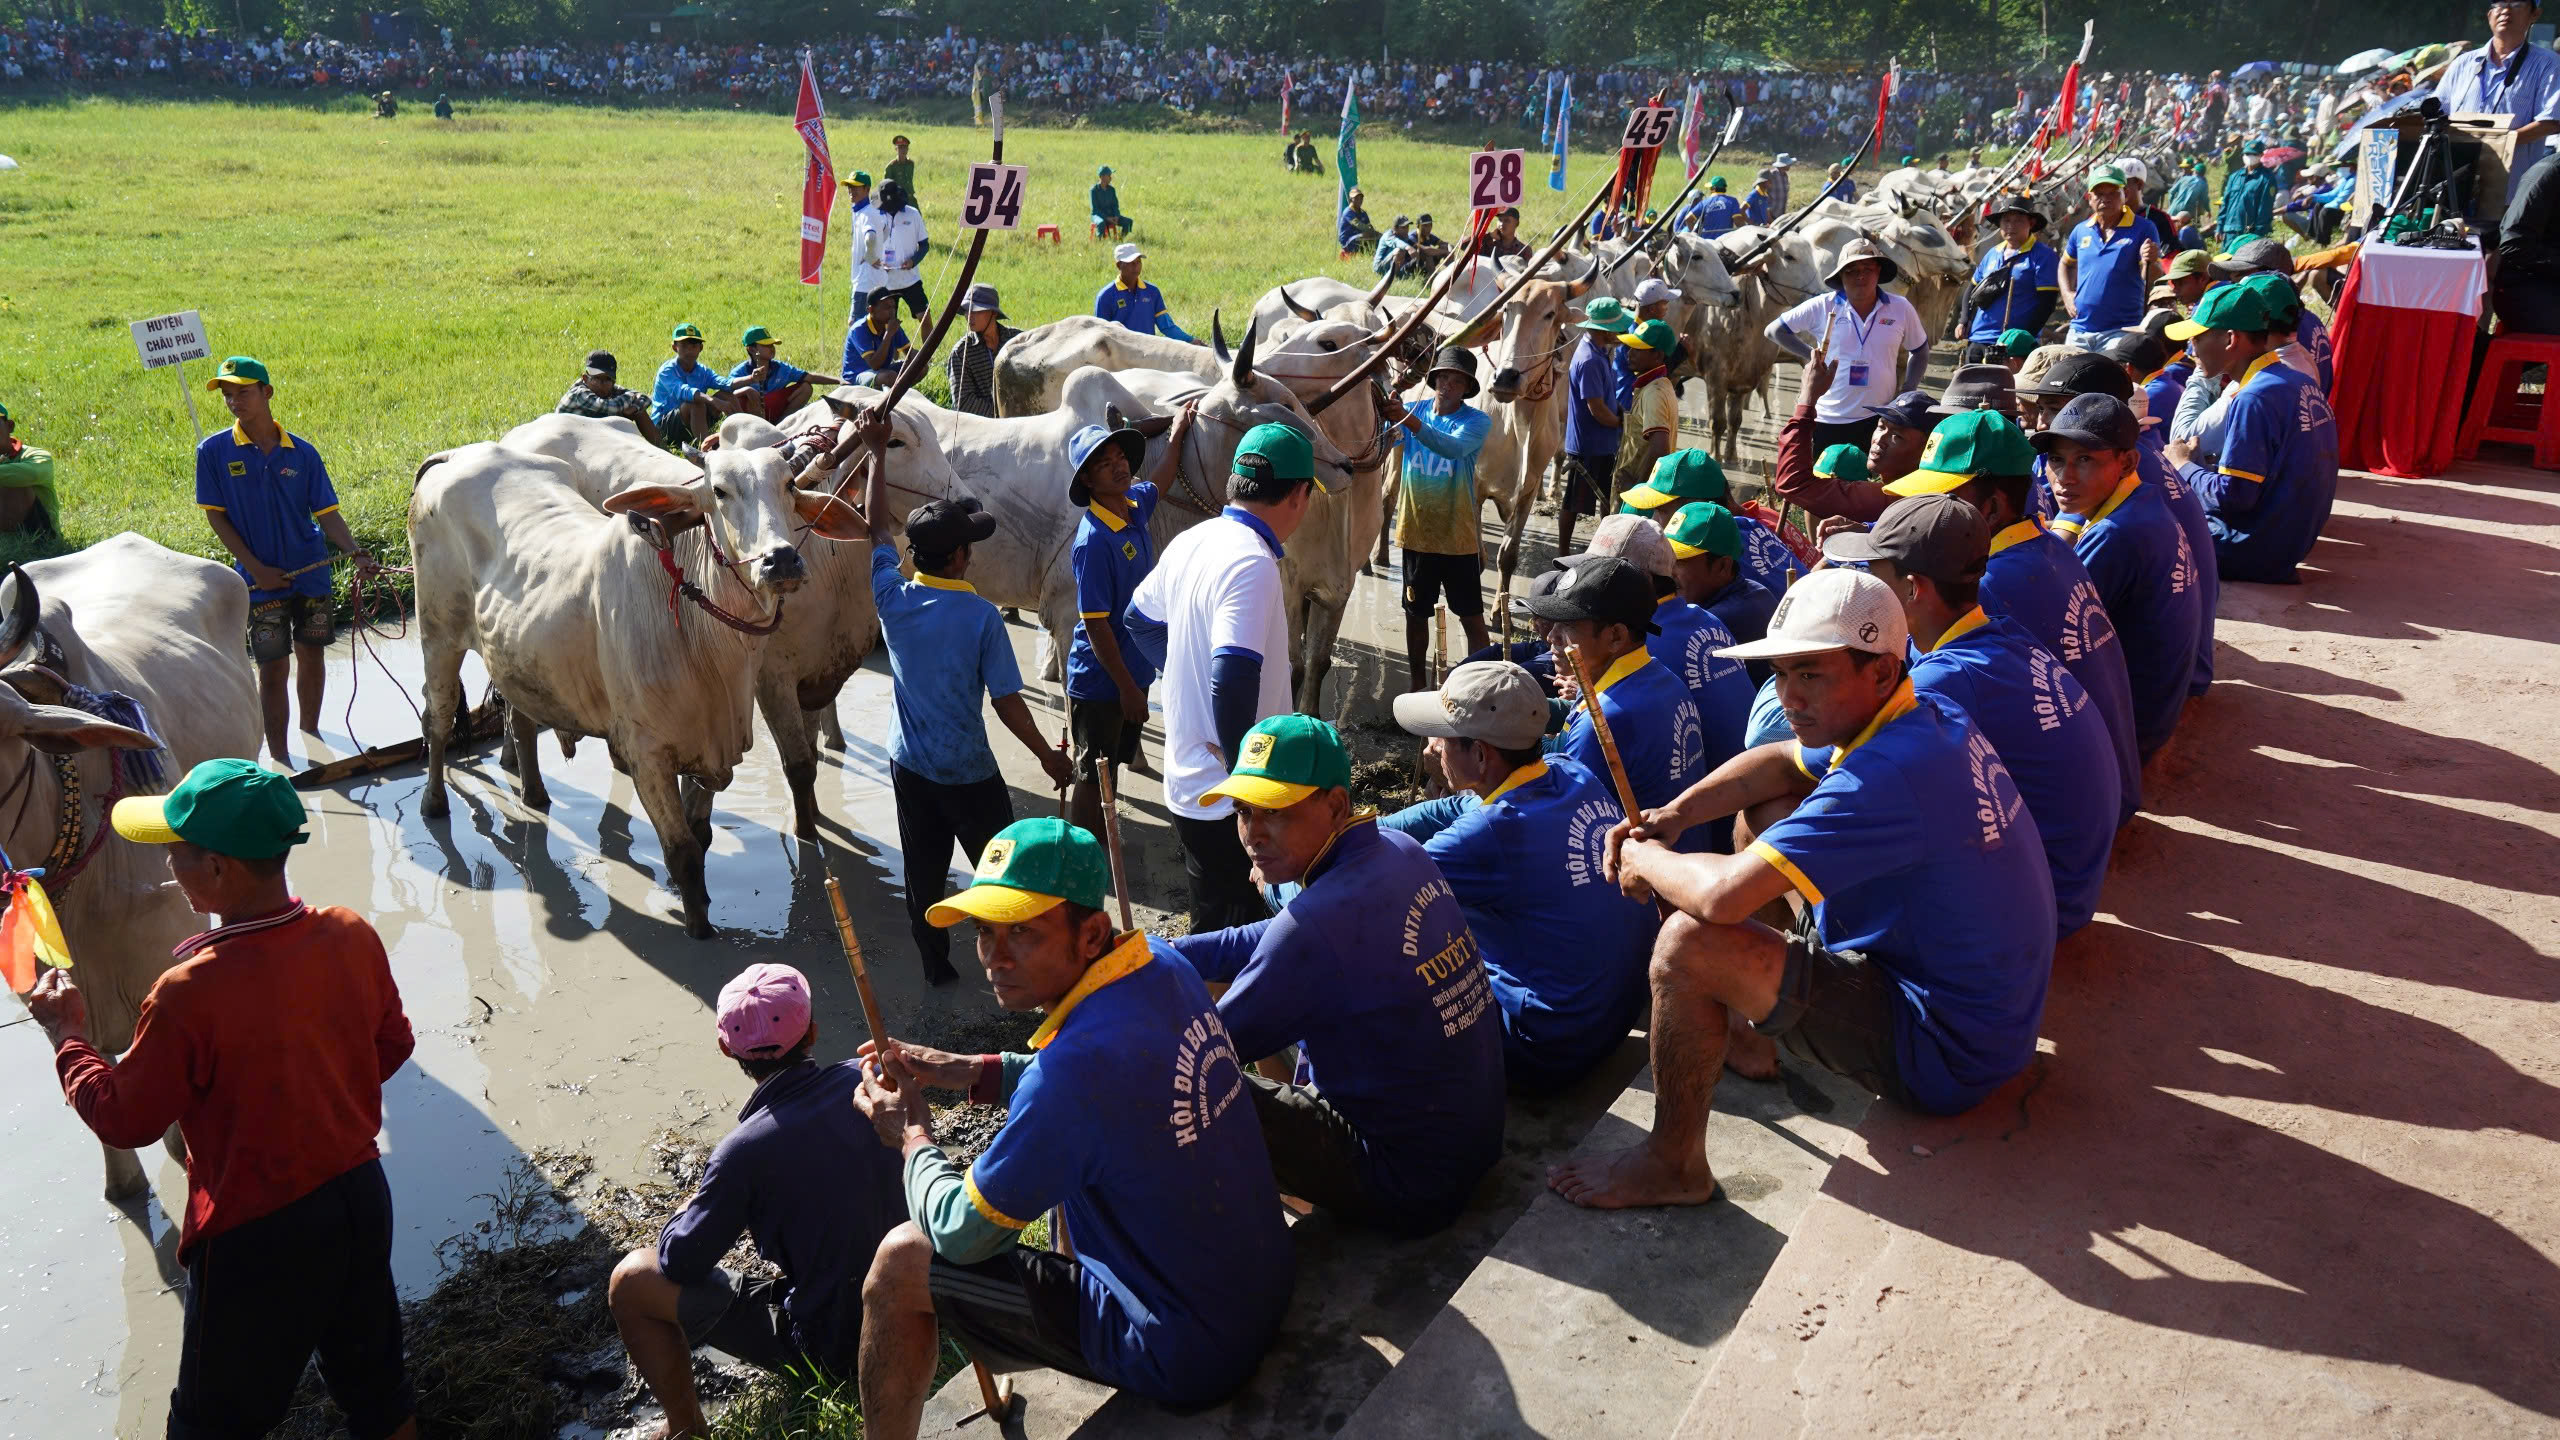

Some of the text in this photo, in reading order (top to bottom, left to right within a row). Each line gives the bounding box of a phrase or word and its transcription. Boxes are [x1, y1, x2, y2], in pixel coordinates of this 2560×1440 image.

[1626, 110, 1674, 145] 45
[1473, 153, 1521, 206] 28
[965, 168, 1021, 226] 54
[146, 316, 184, 333] HUYỆN
[146, 336, 174, 352] CHÂU
[168, 354, 180, 365] AN
[180, 348, 205, 362] GIANG
[1411, 451, 1454, 477] AIA
[1686, 635, 1702, 662] ĐUA
[1695, 626, 1711, 644] BÒ
[2060, 628, 2082, 661] HỘI
[1685, 662, 1702, 690] HỘI
[2033, 694, 2061, 731] HỘI
[1670, 748, 1681, 780] HỘI
[1576, 801, 1598, 825] BÒ
[1593, 797, 1620, 820] BẢY
[1977, 797, 2001, 842] HỘI
[1568, 816, 1587, 850] ĐUA
[1565, 852, 1591, 887] HỘI
[1402, 905, 1423, 957] DNTN
[1414, 882, 1440, 910] HOA
[1415, 932, 1471, 987] TUYẾT
[1440, 1002, 1459, 1021] KHÓM
[1184, 1016, 1208, 1052] BÒ
[1443, 1022, 1459, 1038] DĐ:
[1174, 1043, 1196, 1094] ĐUA
[1169, 1100, 1197, 1147] HỘI
[1199, 1095, 1211, 1129] TRANH
